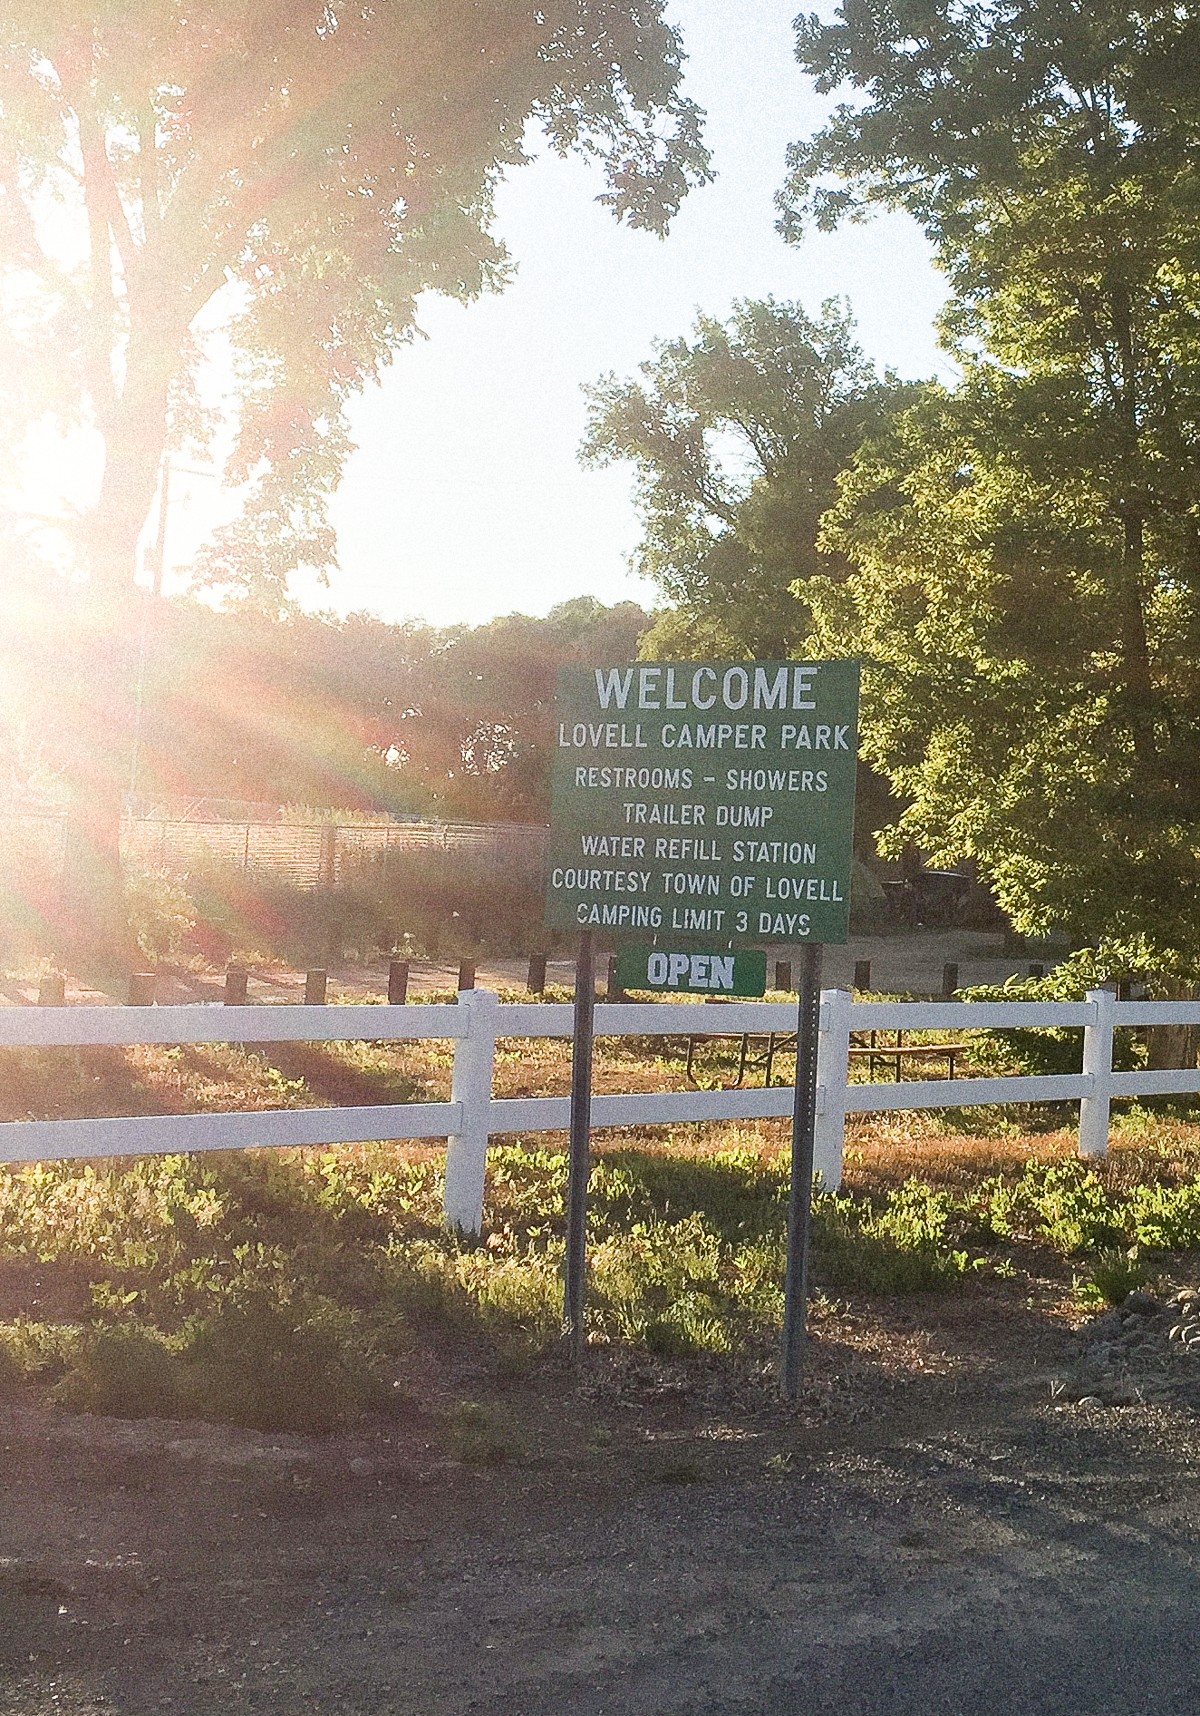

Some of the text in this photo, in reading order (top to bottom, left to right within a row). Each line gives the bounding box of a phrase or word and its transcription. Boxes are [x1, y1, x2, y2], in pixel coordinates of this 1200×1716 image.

[594, 667, 818, 710] WELCOME
[559, 723, 850, 750] LOVELL CAMPER PARK
[575, 766, 693, 789] RESTROOMS
[726, 769, 828, 792] SHOWERS
[623, 802, 773, 828] TRAILER DUMP
[581, 835, 816, 864] WATER REFILL STATION
[552, 867, 843, 901] COURTESY TOWN OF LOVELL
[576, 902, 811, 936] CAMPING LIMIT 3 DAYS
[647, 952, 735, 989] OPEN
